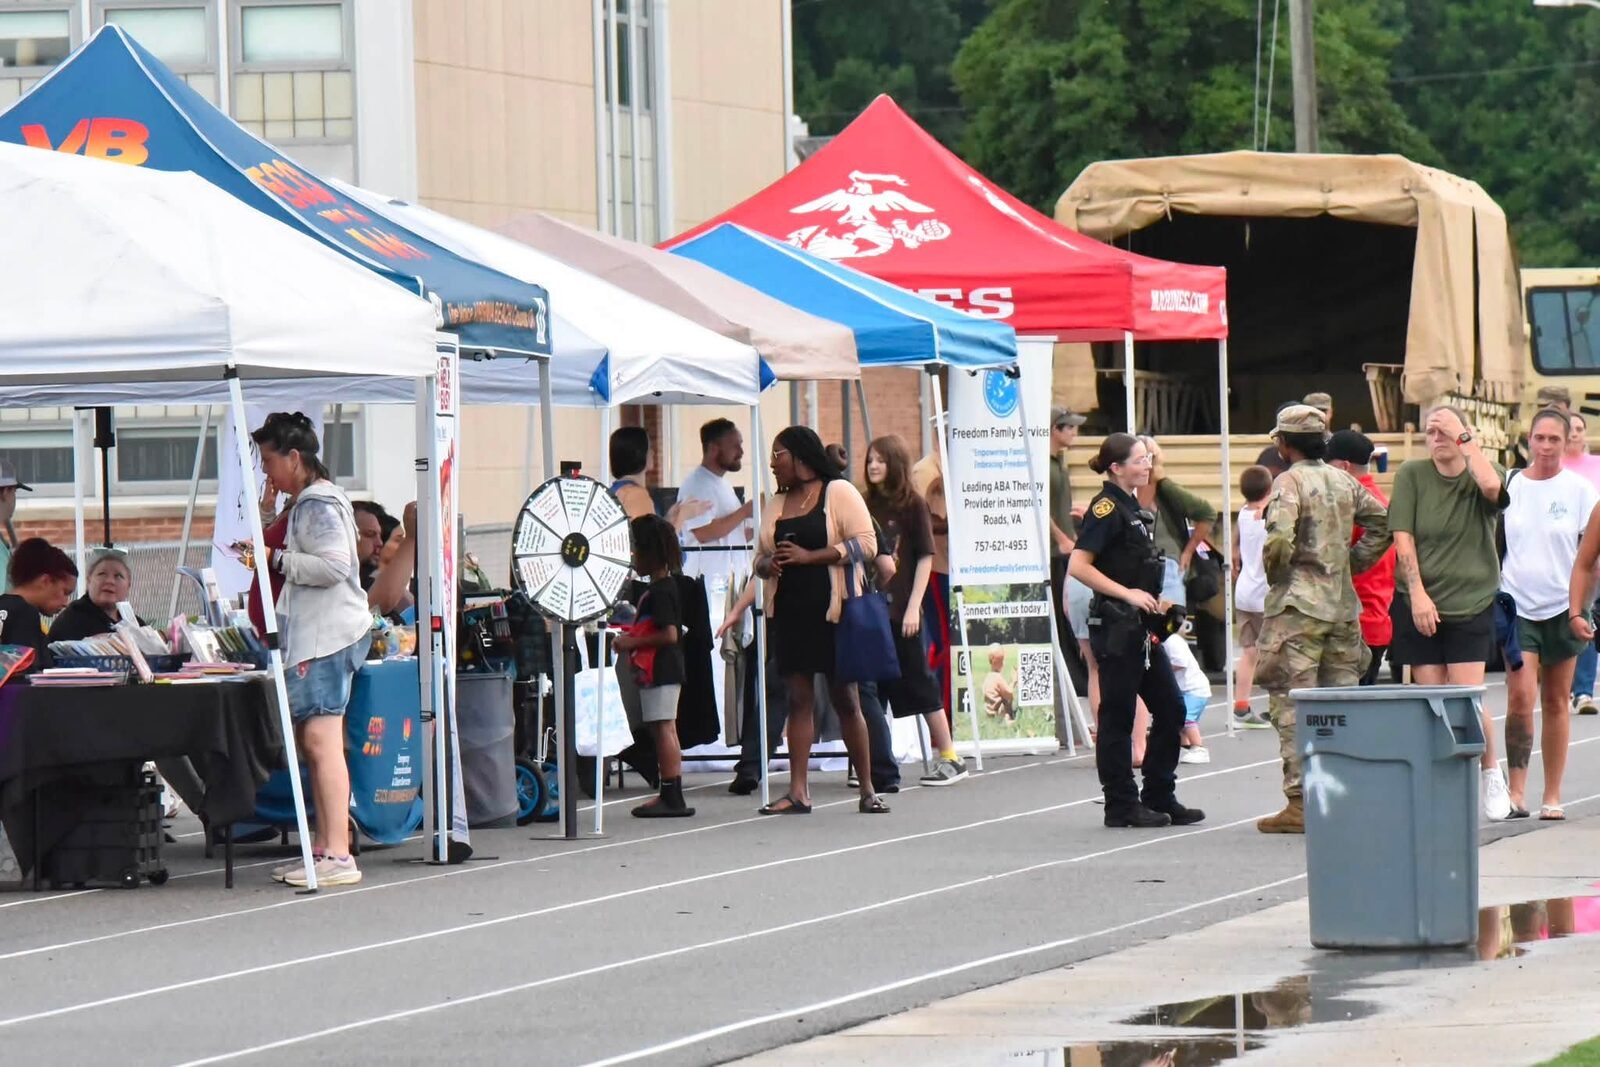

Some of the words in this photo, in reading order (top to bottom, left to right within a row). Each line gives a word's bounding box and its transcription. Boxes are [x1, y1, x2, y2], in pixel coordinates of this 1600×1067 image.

[21, 117, 149, 166] VB
[907, 287, 1015, 319] ES
[952, 428, 988, 439] Freedom
[991, 426, 1017, 439] Family
[1018, 426, 1049, 438] Srvices
[962, 481, 992, 493] Leading
[994, 481, 1010, 491] ABA
[964, 497, 996, 509] Provider
[998, 497, 1005, 508] in
[983, 514, 1009, 525] Roads,
[1010, 513, 1022, 524] VA
[974, 540, 1028, 551] 757-621-4953
[993, 604, 1009, 615] with
[1011, 606, 1019, 614] us
[1021, 603, 1041, 615] today
[1306, 714, 1347, 727] BRUTE
